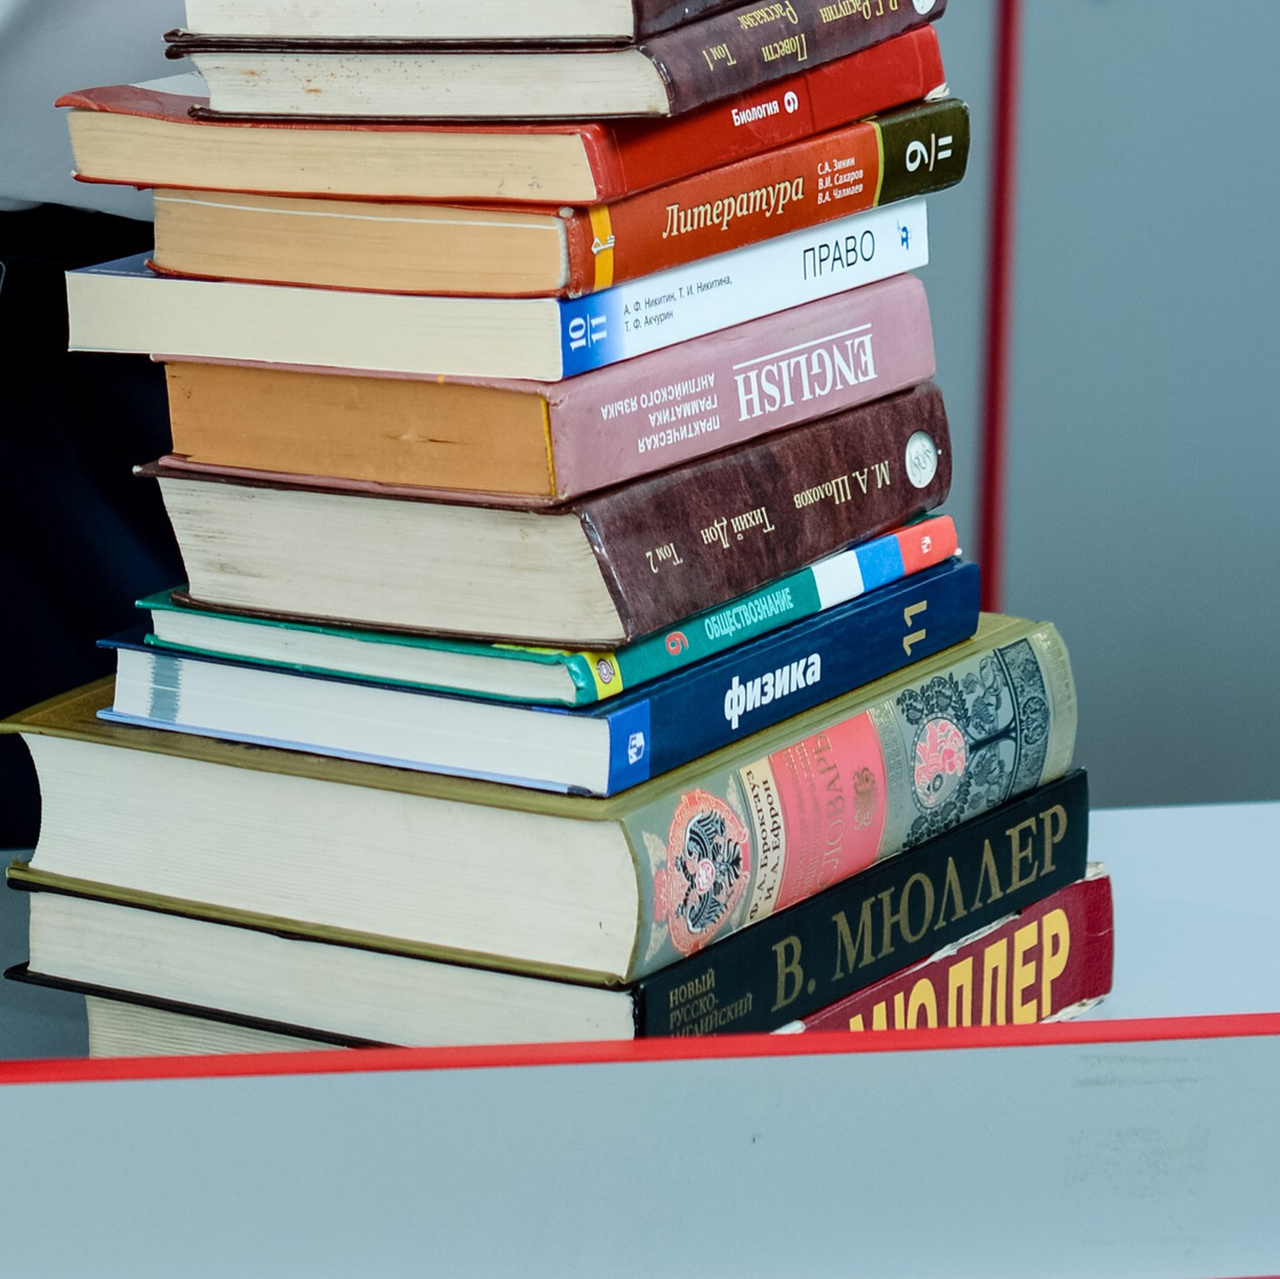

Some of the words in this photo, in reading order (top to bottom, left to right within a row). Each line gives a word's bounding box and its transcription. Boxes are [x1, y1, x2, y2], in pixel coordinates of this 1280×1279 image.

[702, 49, 714, 72] 1
[712, 43, 737, 66] Том
[762, 33, 808, 62] Повести
[731, 99, 780, 127] Биология
[662, 176, 805, 240] Литература
[802, 229, 876, 281] ПРАВО
[569, 316, 588, 353] 10
[590, 314, 608, 345] 11
[640, 372, 716, 409] АНГЛИЙСКОГО
[733, 333, 878, 422] ENGLISH
[600, 395, 639, 422] ЯЗЫКА
[648, 393, 719, 428] ГРАММАТИКА
[637, 414, 721, 454] ПРАКТИЧЕСКАЯ
[793, 474, 852, 510] Шолохов
[851, 469, 869, 495] А.
[870, 459, 892, 489] М.
[700, 516, 730, 549] Дон
[730, 505, 776, 542] Тихий
[645, 550, 658, 574] 2
[657, 541, 684, 566] Том
[704, 586, 795, 641] ОБЩЕСТВОЗНАНИЕ
[902, 600, 928, 657] 11
[724, 652, 822, 730] физика
[746, 769, 771, 869] Брокгауз
[762, 778, 784, 853] Ефрон
[770, 933, 816, 1014] В.
[831, 803, 1068, 983] МЮЛЛЕР
[669, 966, 716, 1009] НОВЫЙ
